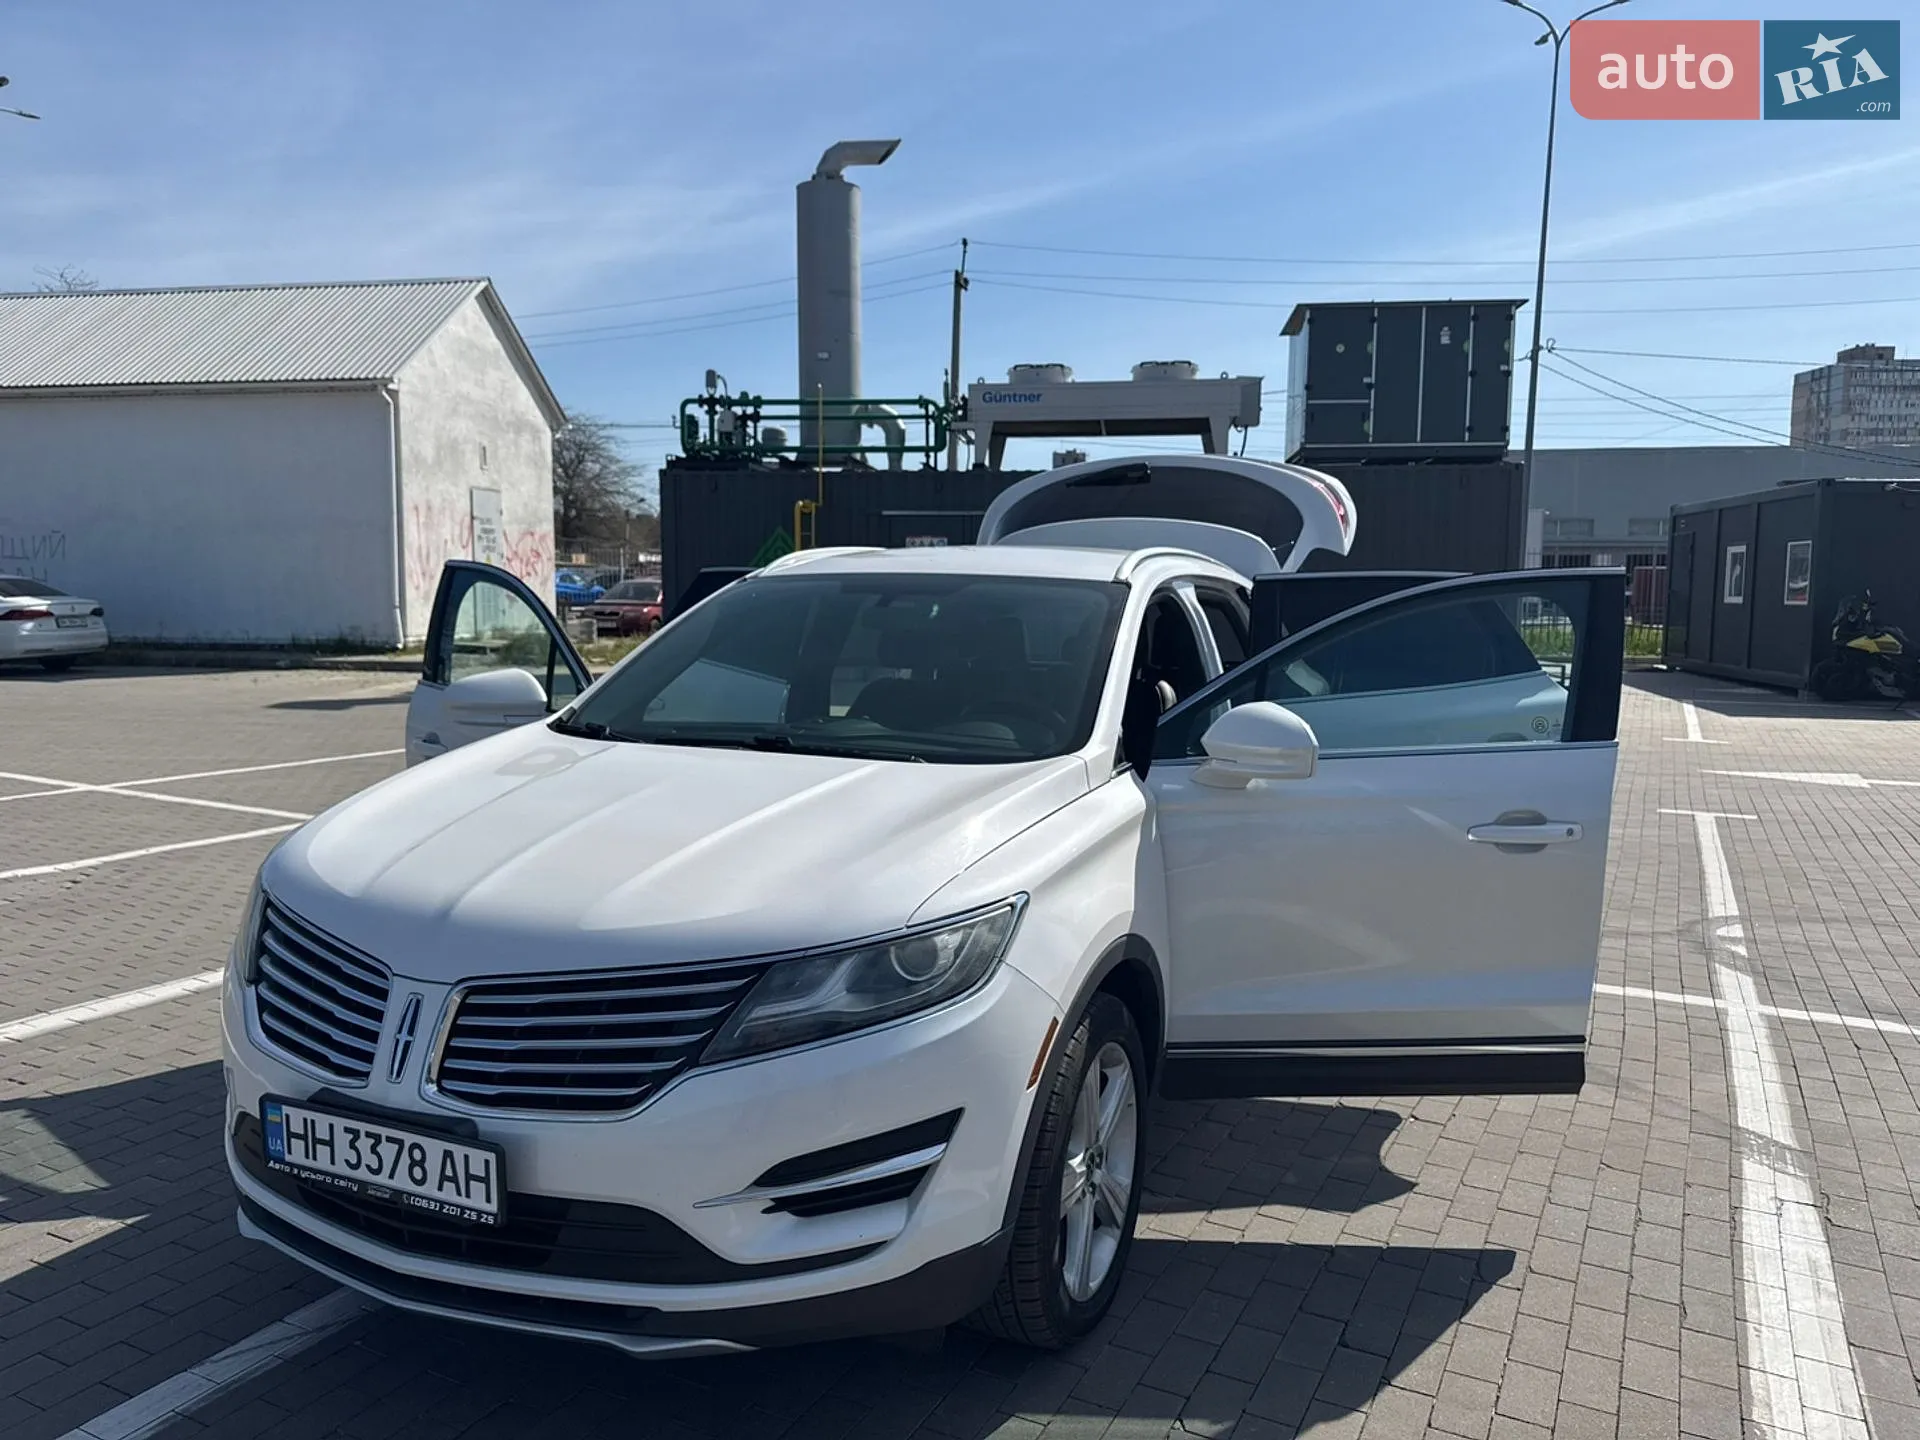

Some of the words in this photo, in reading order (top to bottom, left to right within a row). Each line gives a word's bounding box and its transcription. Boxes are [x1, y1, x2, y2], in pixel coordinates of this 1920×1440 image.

[268, 1137, 284, 1153] UA
[285, 1113, 336, 1166] HH
[343, 1127, 428, 1188] 3378
[437, 1148, 492, 1204] AH
[267, 1160, 290, 1173] Авто
[442, 1204, 461, 1216] 201
